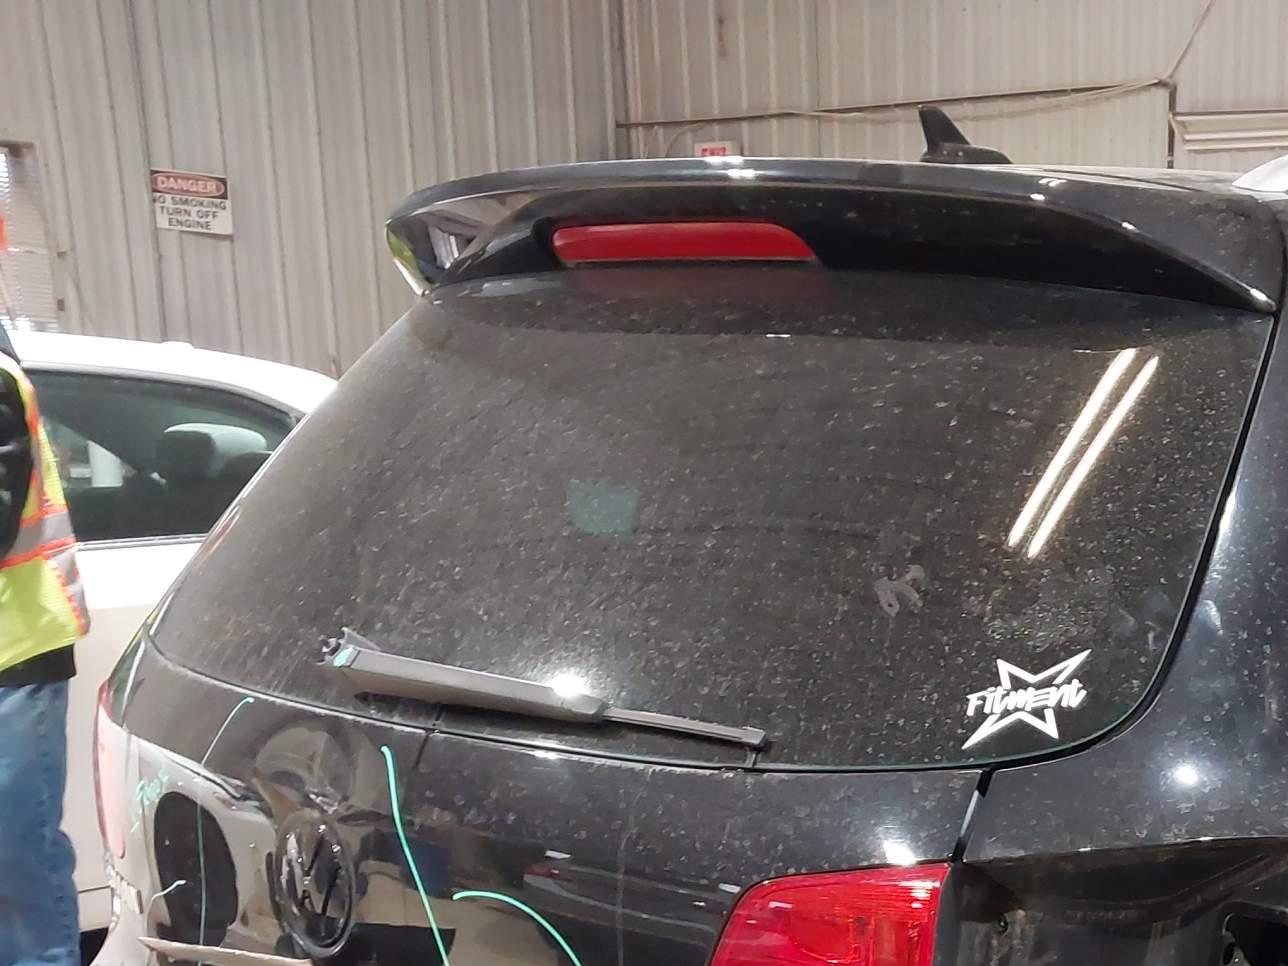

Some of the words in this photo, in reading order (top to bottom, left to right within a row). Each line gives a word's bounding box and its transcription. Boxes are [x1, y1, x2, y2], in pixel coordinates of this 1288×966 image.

[157, 176, 217, 192] DANGER
[171, 196, 227, 210] SMOKING
[160, 206, 192, 216] TURN
[196, 209, 219, 219] OFF
[168, 217, 212, 230] ENGINE
